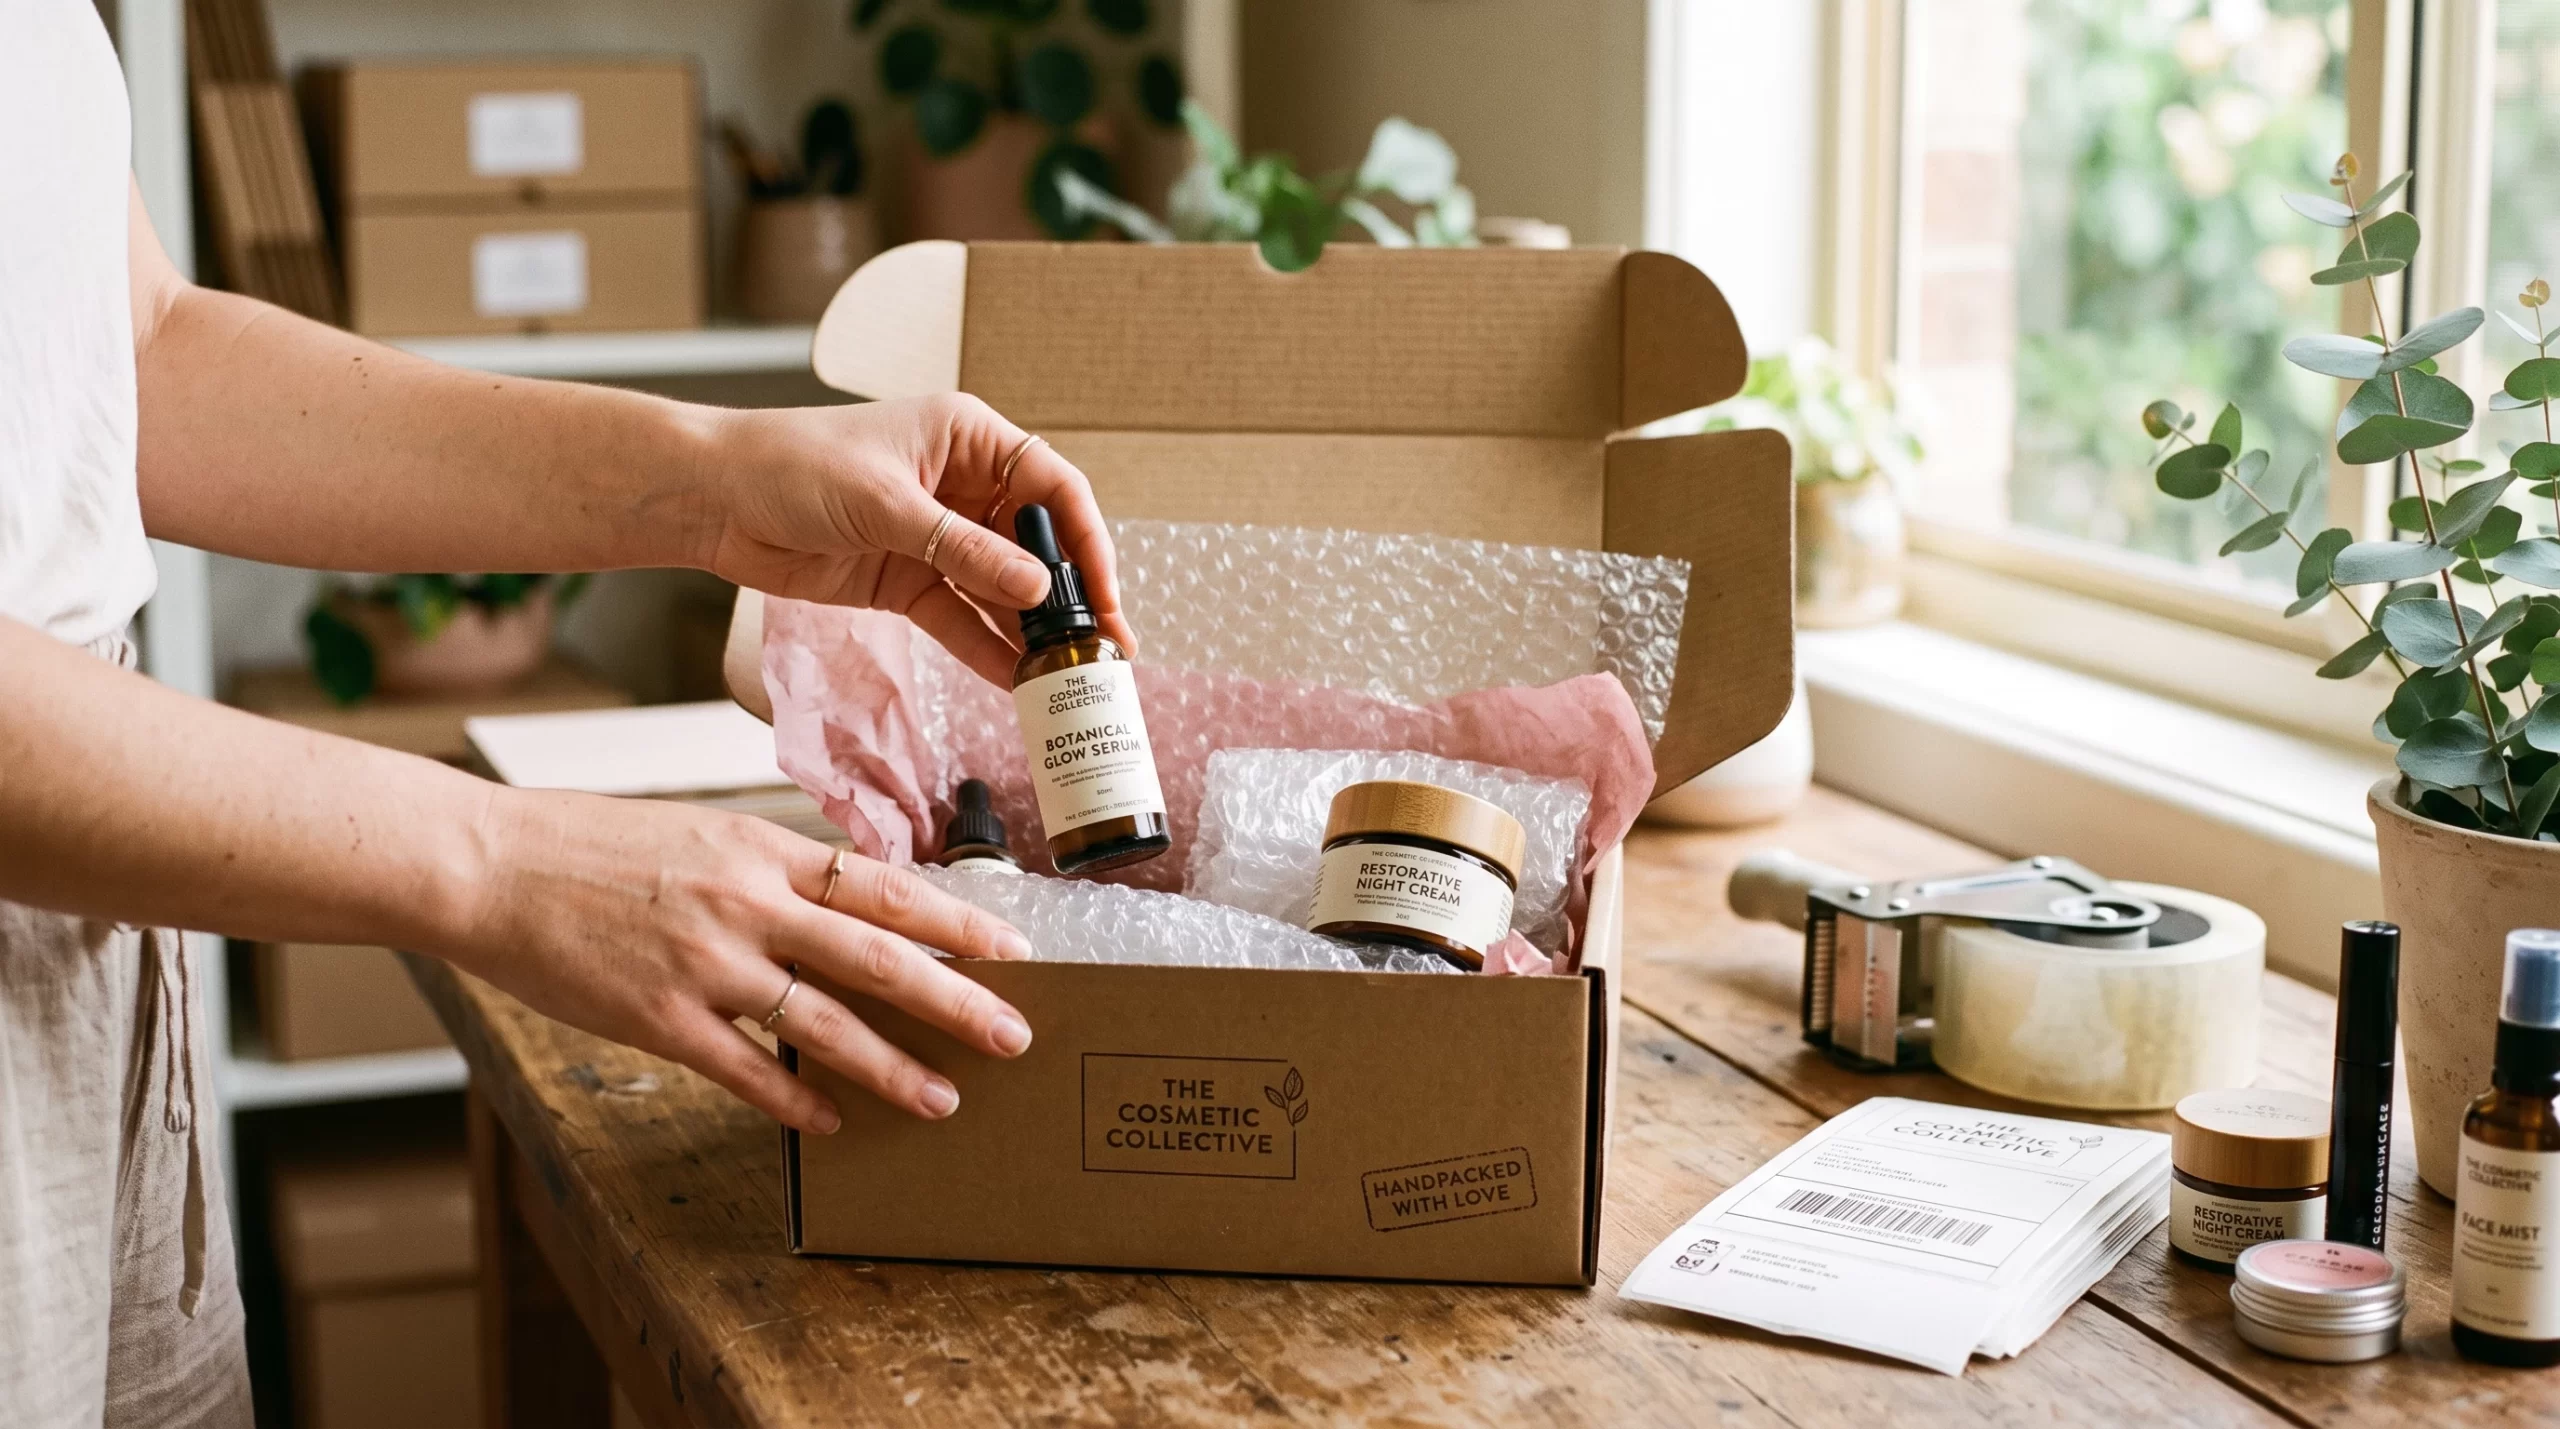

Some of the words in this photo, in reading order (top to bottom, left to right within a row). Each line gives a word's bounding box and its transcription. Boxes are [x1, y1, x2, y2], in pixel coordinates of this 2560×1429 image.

[1049, 683, 1106, 703] COSMETIC
[1065, 676, 1087, 688] THE
[1048, 693, 1113, 715] COLLECTIVE
[1045, 723, 1131, 752] BOTANICAL
[1044, 747, 1086, 770] GLOW
[1091, 739, 1141, 756] SERUM
[1360, 863, 1462, 891] RESTORATIVE
[1356, 877, 1406, 892] NIGHT
[1409, 883, 1461, 907] CREAM
[1162, 1078, 1215, 1099] THE
[1118, 1103, 1260, 1127] COSMETIC
[1975, 1121, 2026, 1133] THE
[1106, 1128, 1273, 1154] COLLECTIVE
[1894, 1126, 2059, 1158] COLLECTIVE
[1914, 1121, 2058, 1148] COSMETIC
[1373, 1161, 1521, 1198] HANDPACKED
[1392, 1194, 1448, 1217] WITH
[1454, 1184, 1510, 1208] LOVE
[2193, 1218, 2232, 1237] NIGHT
[2235, 1228, 2285, 1240] CREAM
[2194, 1205, 2283, 1228] RESTORATIVE
[2462, 1211, 2495, 1236] FACE
[2499, 1223, 2541, 1240] MIST
